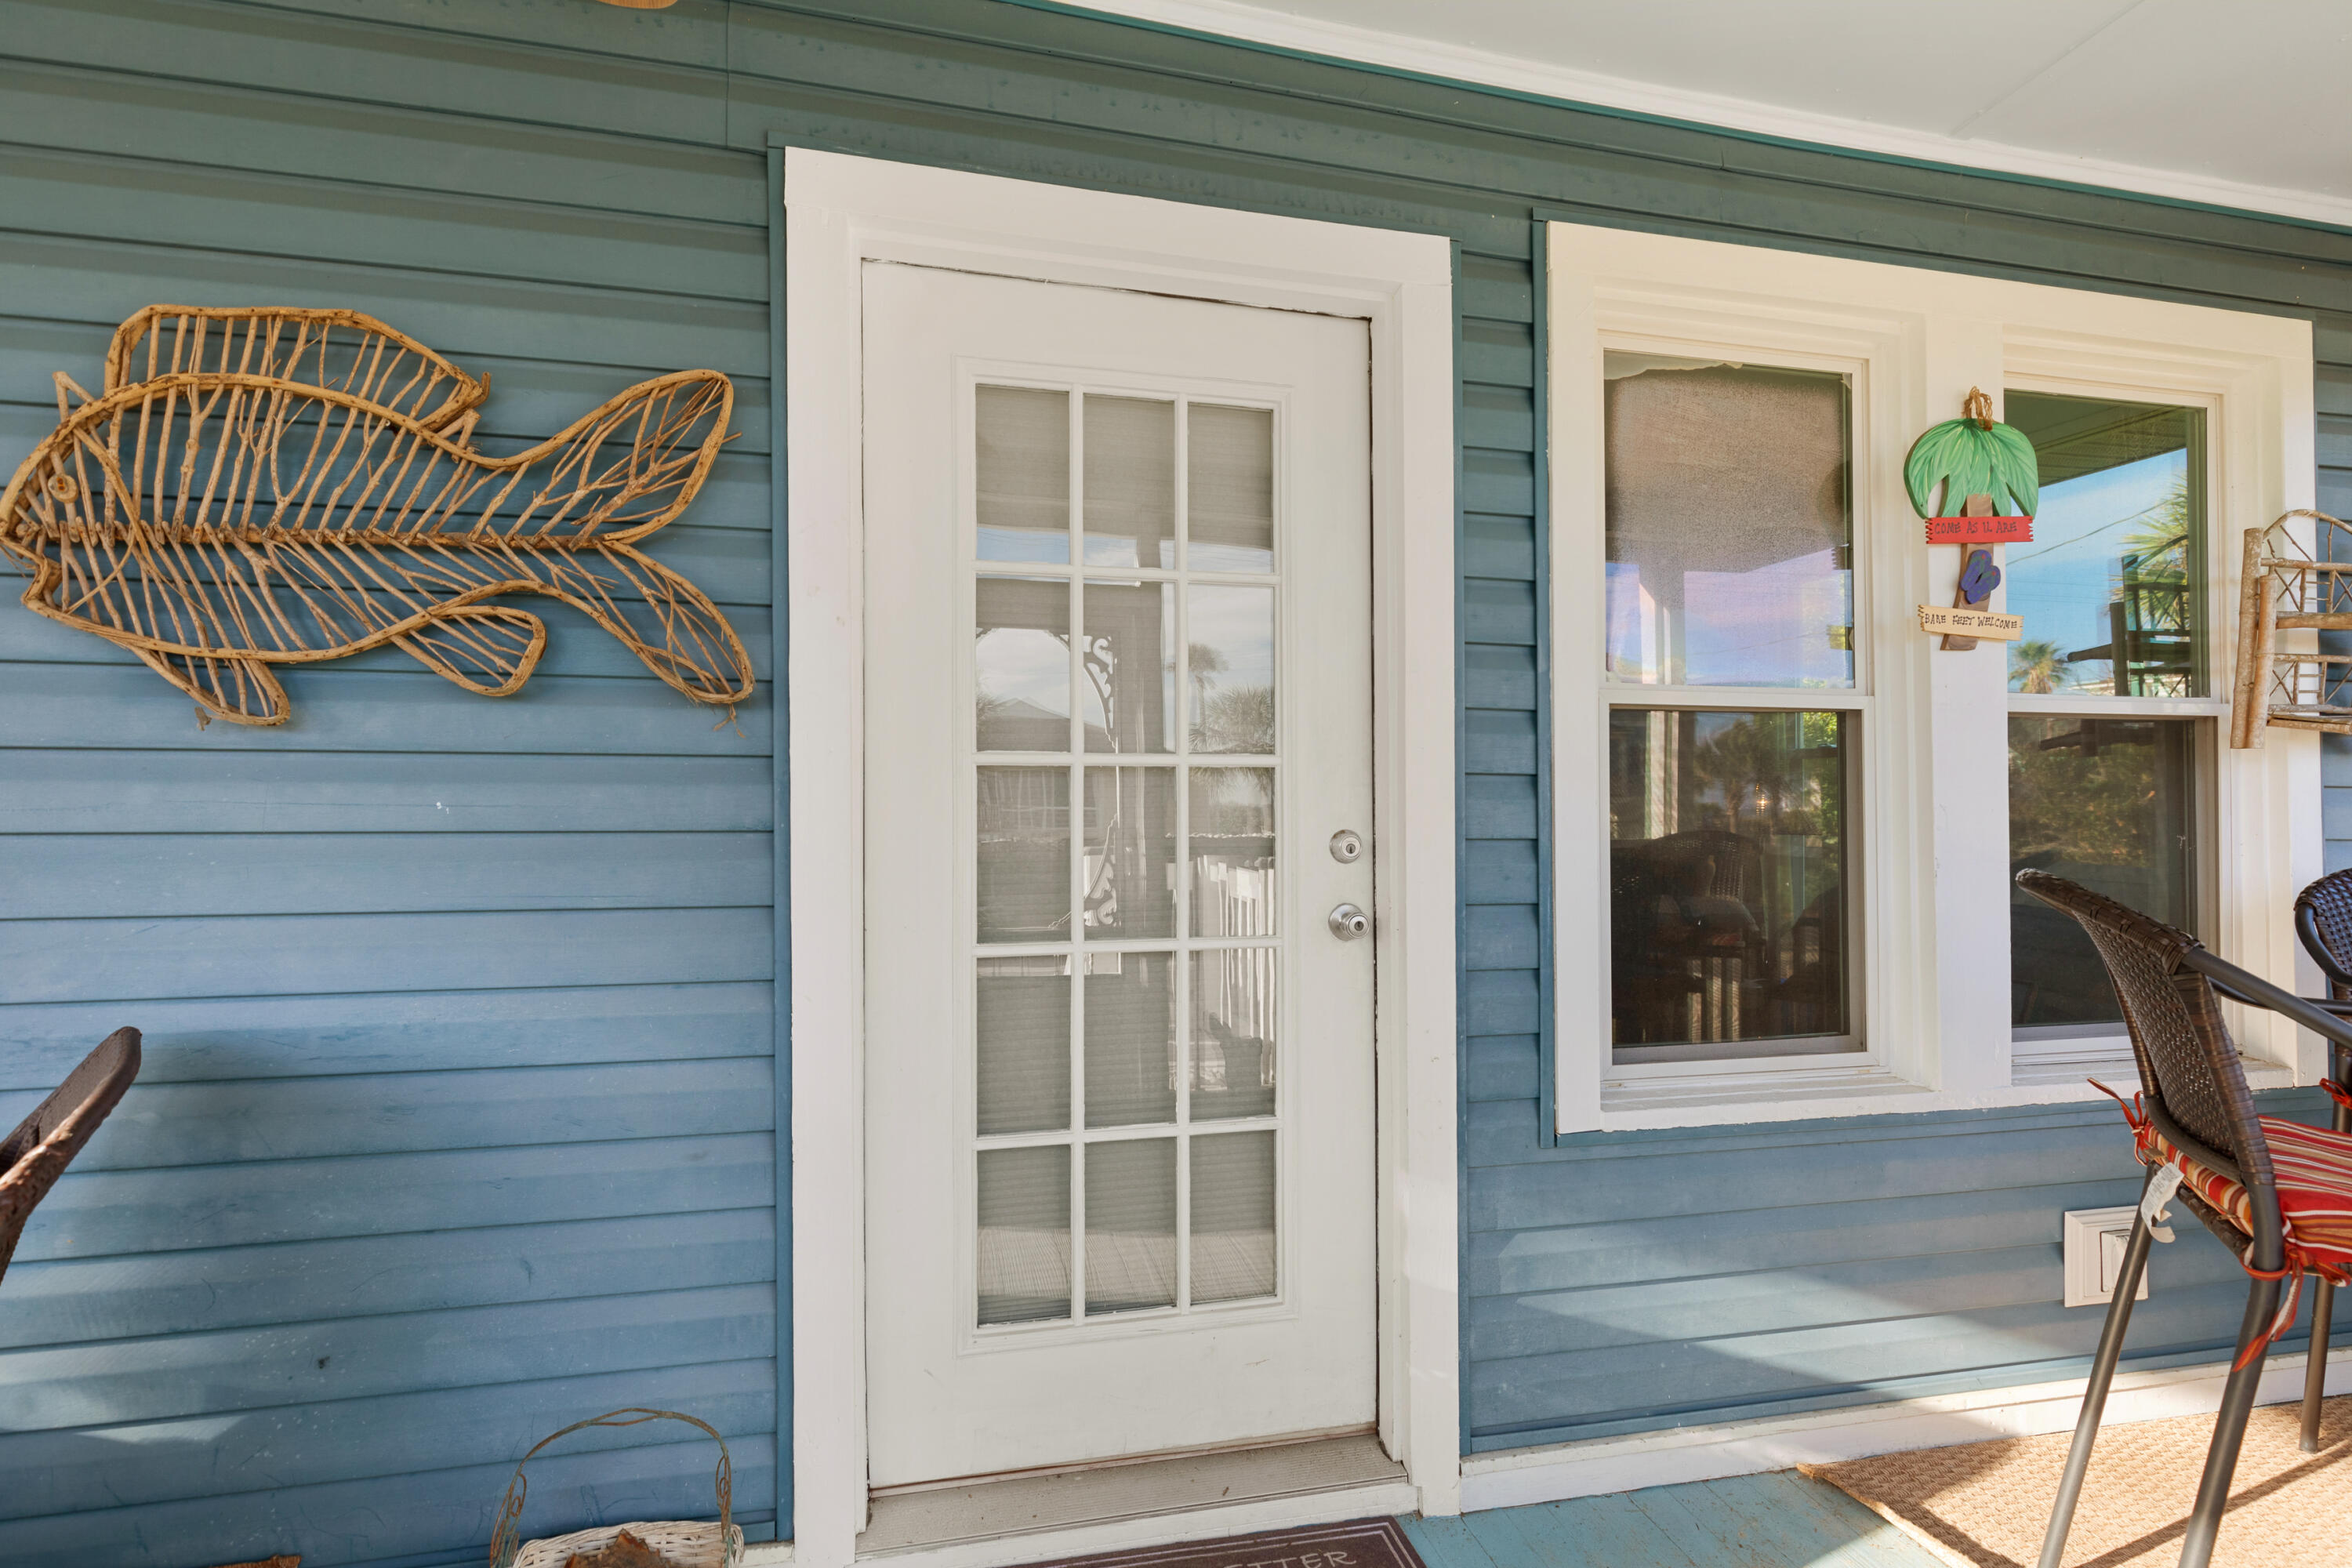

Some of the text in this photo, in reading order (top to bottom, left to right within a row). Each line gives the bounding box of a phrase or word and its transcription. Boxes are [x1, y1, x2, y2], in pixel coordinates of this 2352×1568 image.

[1934, 522, 1962, 534] COME
[1966, 521, 1978, 534] AS
[1996, 521, 2018, 533] ARE
[1925, 613, 2018, 630] BARE FEET WELCOME
[1223, 1551, 1357, 1568] TER
